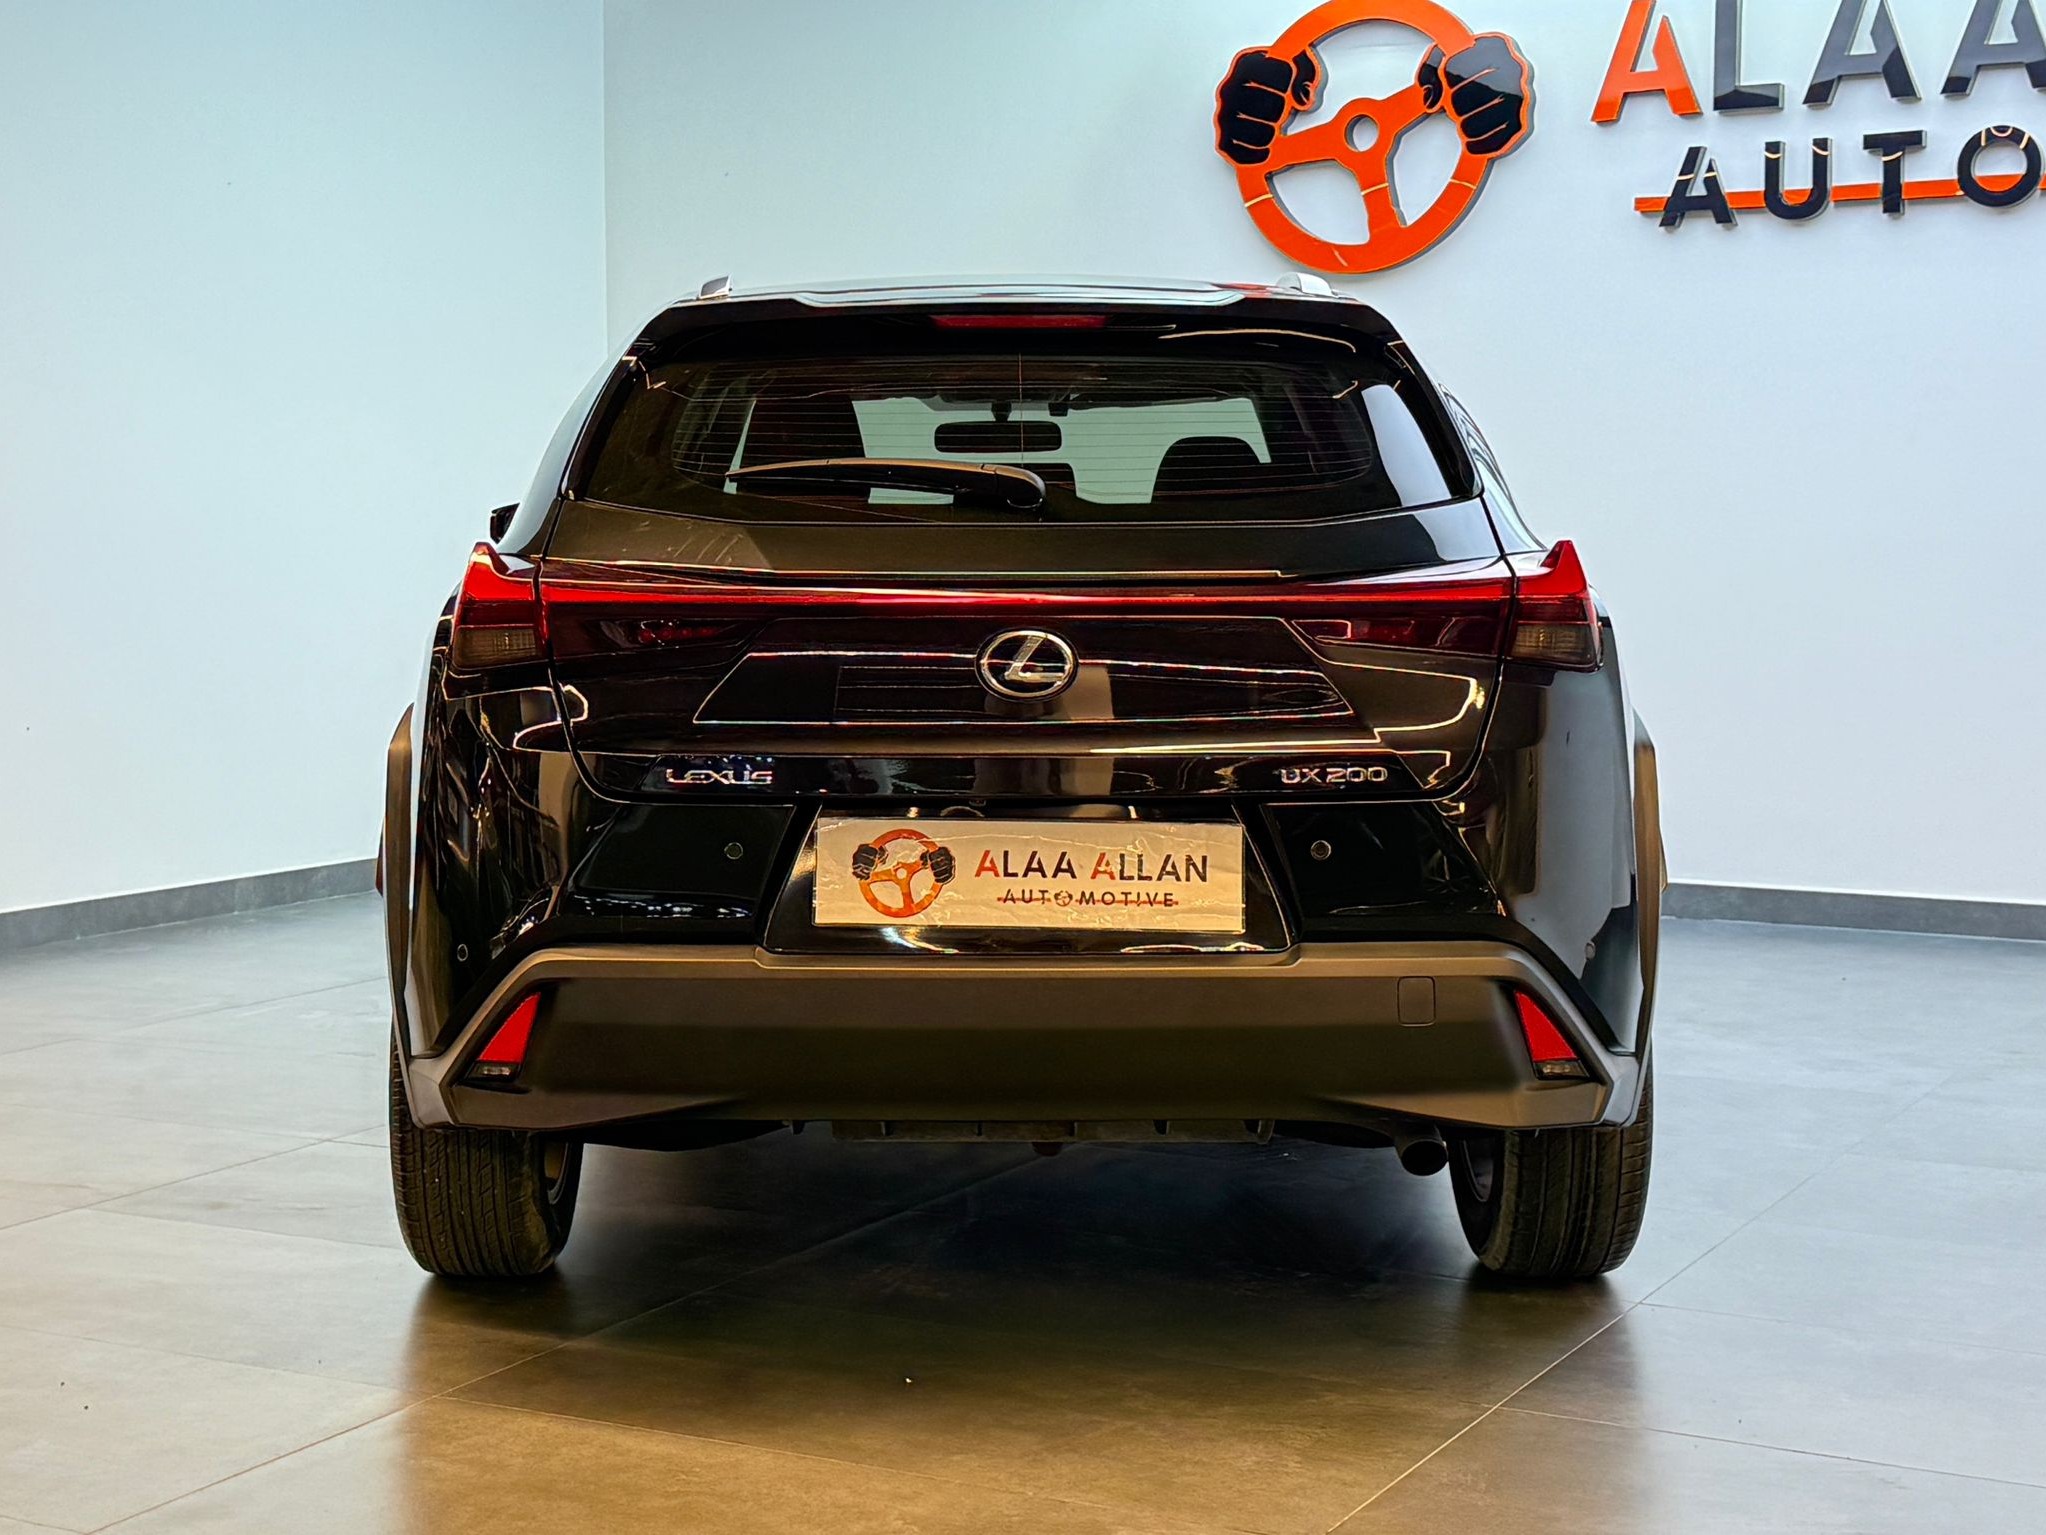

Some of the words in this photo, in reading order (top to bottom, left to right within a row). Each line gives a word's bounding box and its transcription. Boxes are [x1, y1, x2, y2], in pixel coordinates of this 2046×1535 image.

[1590, 0, 2046, 124] ALAA
[665, 768, 774, 785] LEXUS
[974, 849, 1078, 880] ALAA
[1090, 851, 1208, 883] ALLAN
